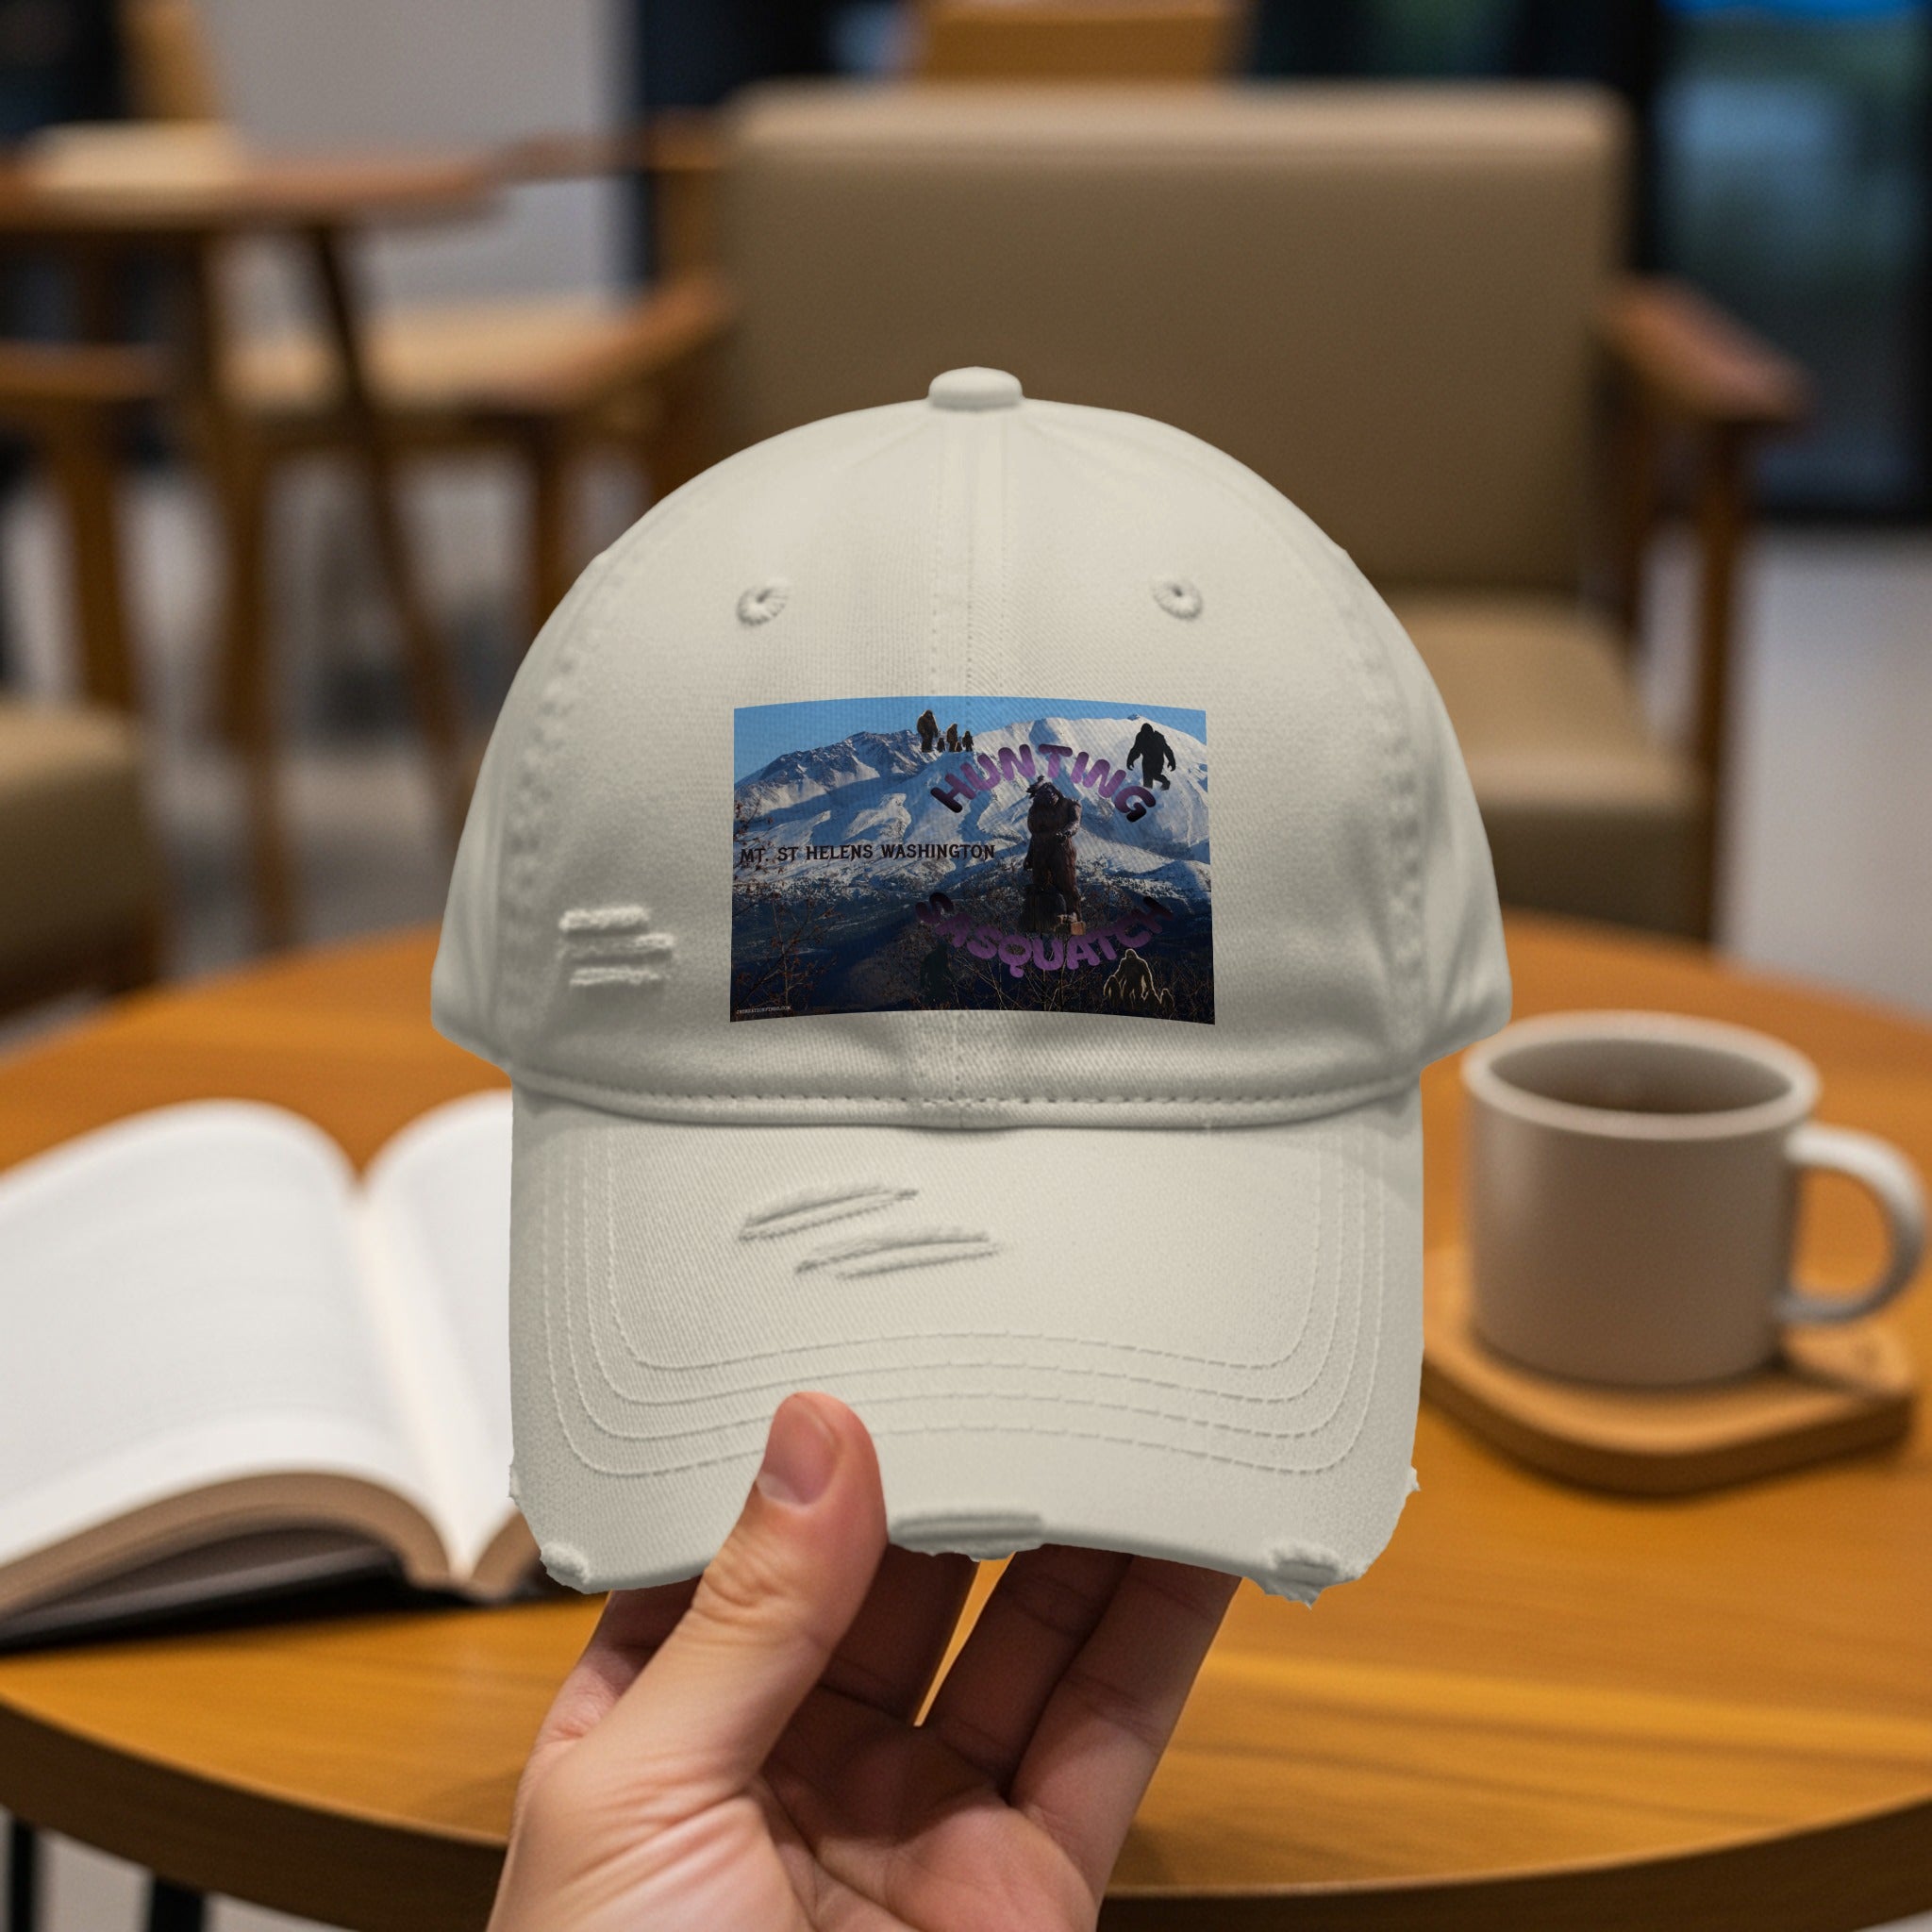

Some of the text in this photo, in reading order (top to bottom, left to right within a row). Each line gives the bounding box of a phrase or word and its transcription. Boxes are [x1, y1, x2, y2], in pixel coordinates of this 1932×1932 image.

[930, 743, 1157, 823] HUNTING
[740, 843, 996, 863] MT. ST HELENS WASHINGTON
[915, 891, 1174, 978] SASQUATCH
